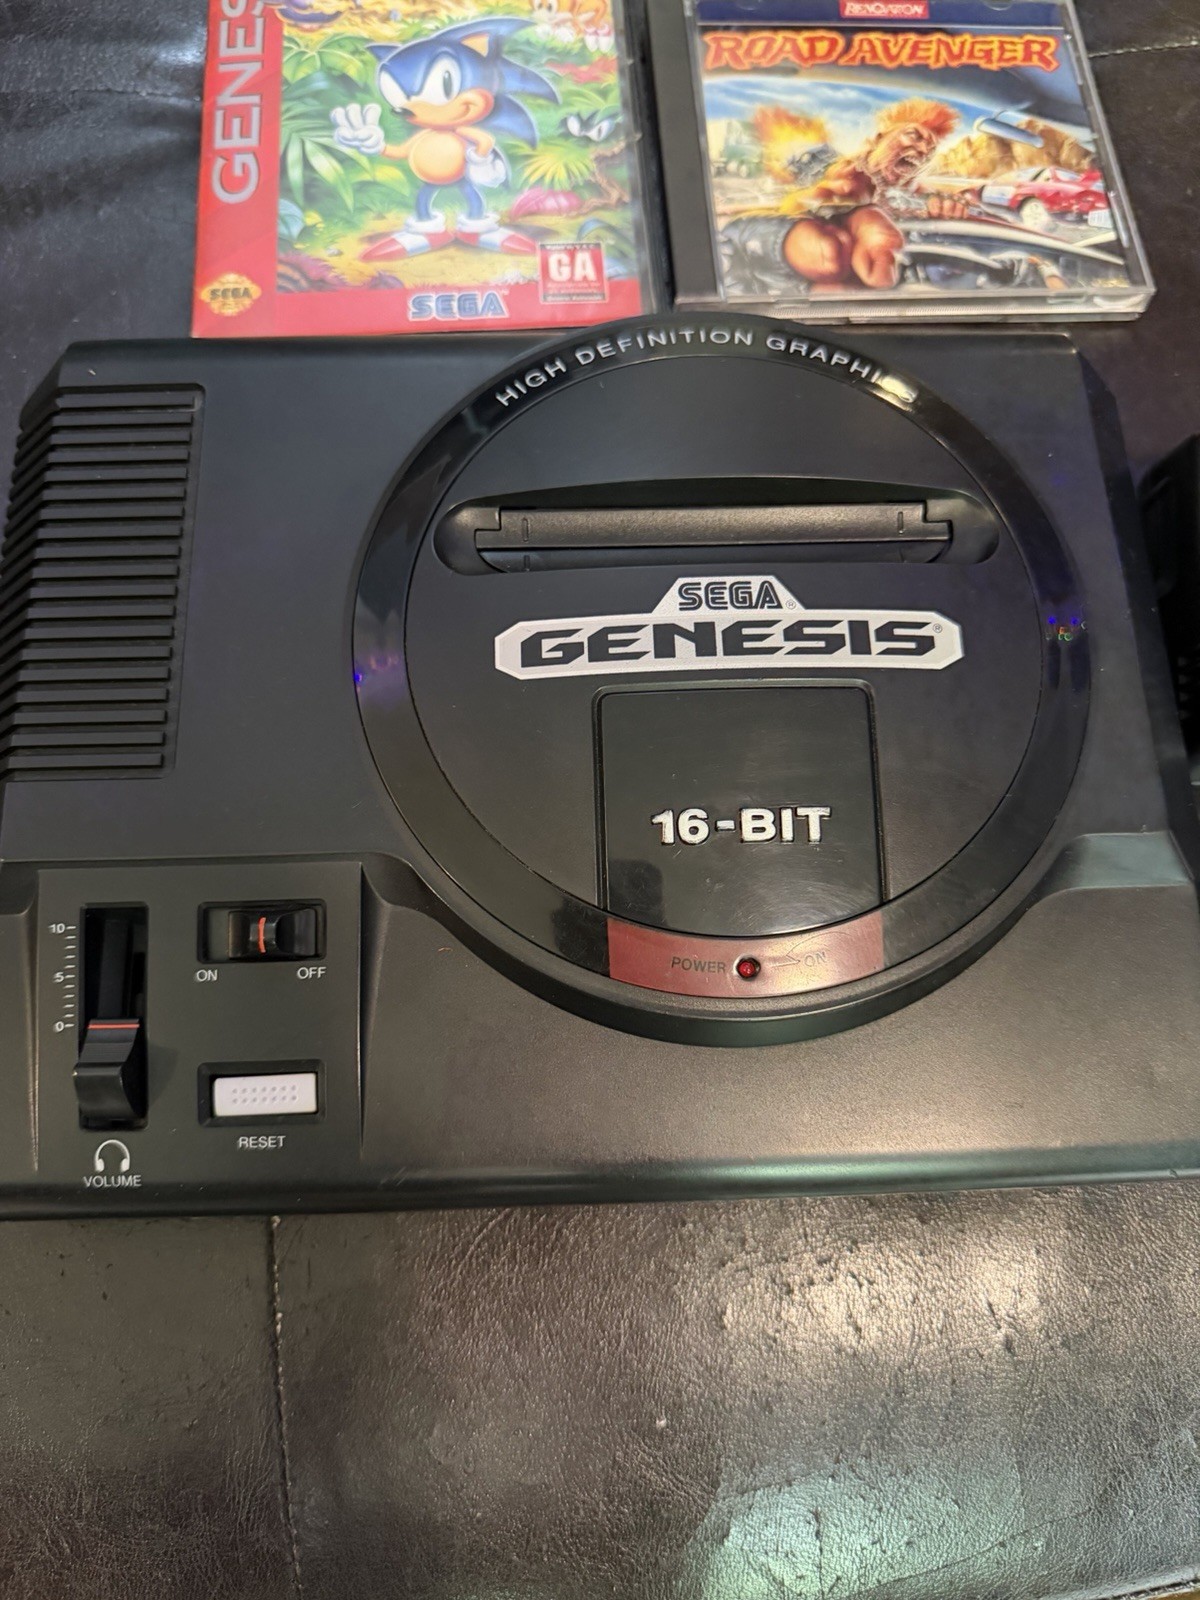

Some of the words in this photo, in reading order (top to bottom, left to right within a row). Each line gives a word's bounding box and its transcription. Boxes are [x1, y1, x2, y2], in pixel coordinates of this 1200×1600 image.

[703, 30, 842, 71] ROAD
[838, 31, 1061, 72] AVENGER
[548, 251, 598, 282] GA
[210, 287, 253, 301] SEGA
[408, 290, 510, 321] SEGA
[495, 357, 567, 407] HIGH
[575, 328, 754, 366] DEFINITION
[766, 332, 919, 404] GRAPHIS
[678, 580, 783, 611] SEGA
[520, 619, 936, 669] GENESIS
[651, 805, 832, 845] 16-BIT
[49, 923, 66, 934] 10
[671, 956, 727, 974] POWER
[804, 951, 826, 967] ON
[52, 971, 64, 983] 5
[194, 969, 218, 983] ON
[296, 966, 326, 980] OFF
[53, 1021, 64, 1032] 0
[237, 1135, 286, 1149] RESET
[83, 1174, 142, 1188] VOLUME
